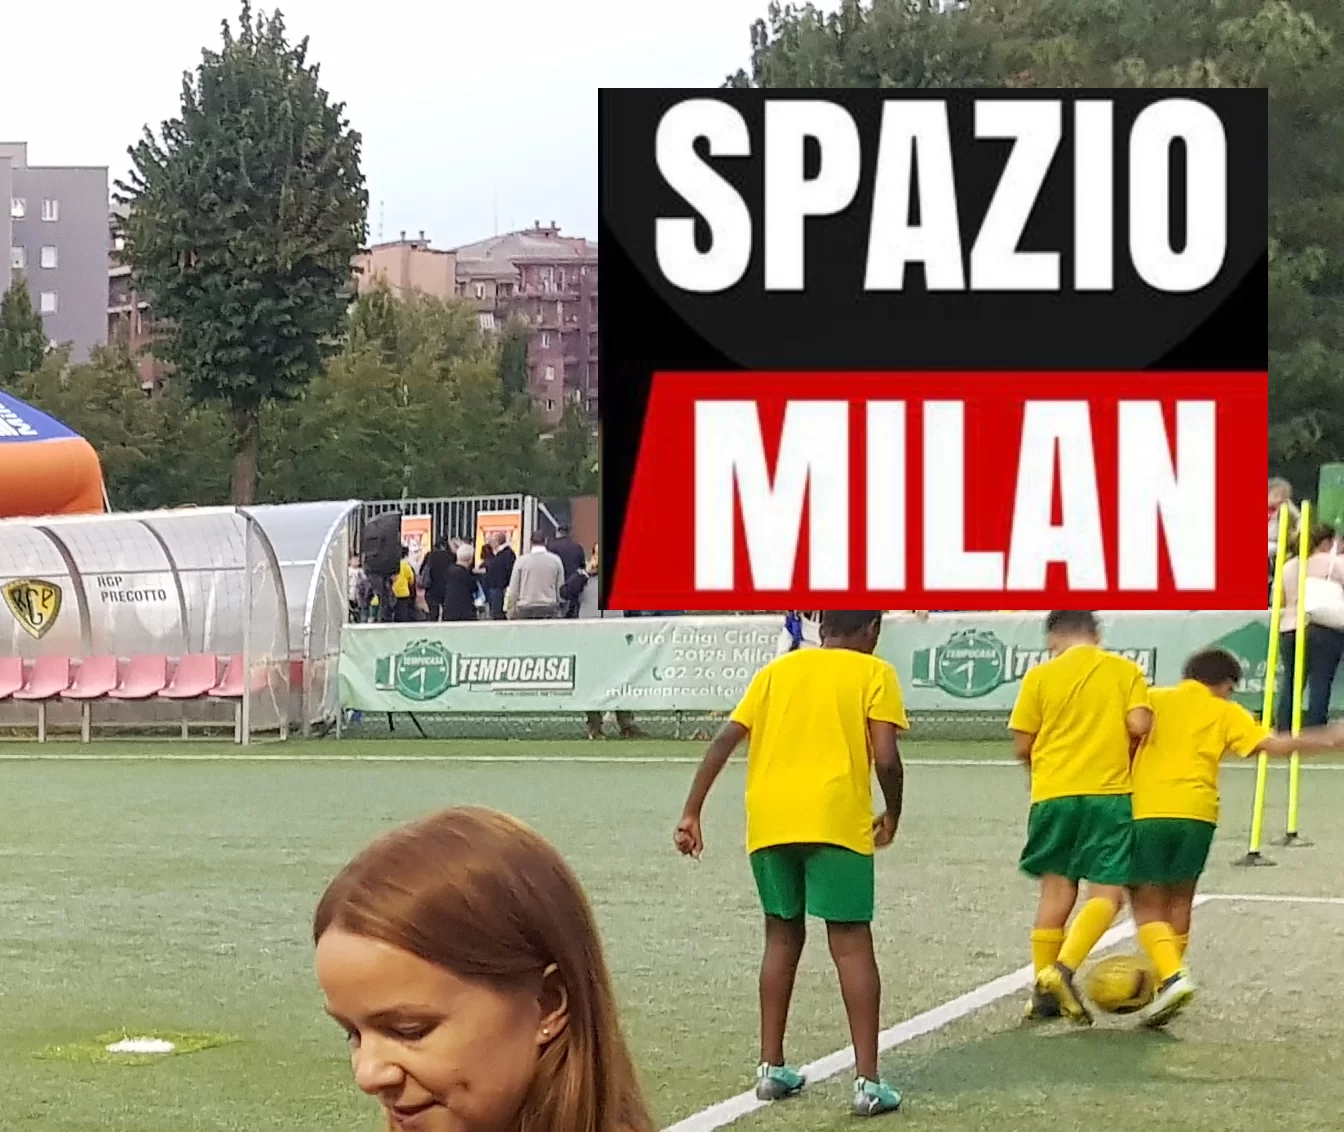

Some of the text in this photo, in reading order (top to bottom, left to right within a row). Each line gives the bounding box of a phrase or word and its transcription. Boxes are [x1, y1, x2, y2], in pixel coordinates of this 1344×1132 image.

[101, 589, 167, 603] PRECOTTO
[672, 630, 717, 647] Luigi
[674, 648, 774, 663] 20128 Mila
[459, 657, 571, 681] TEMPOCASA
